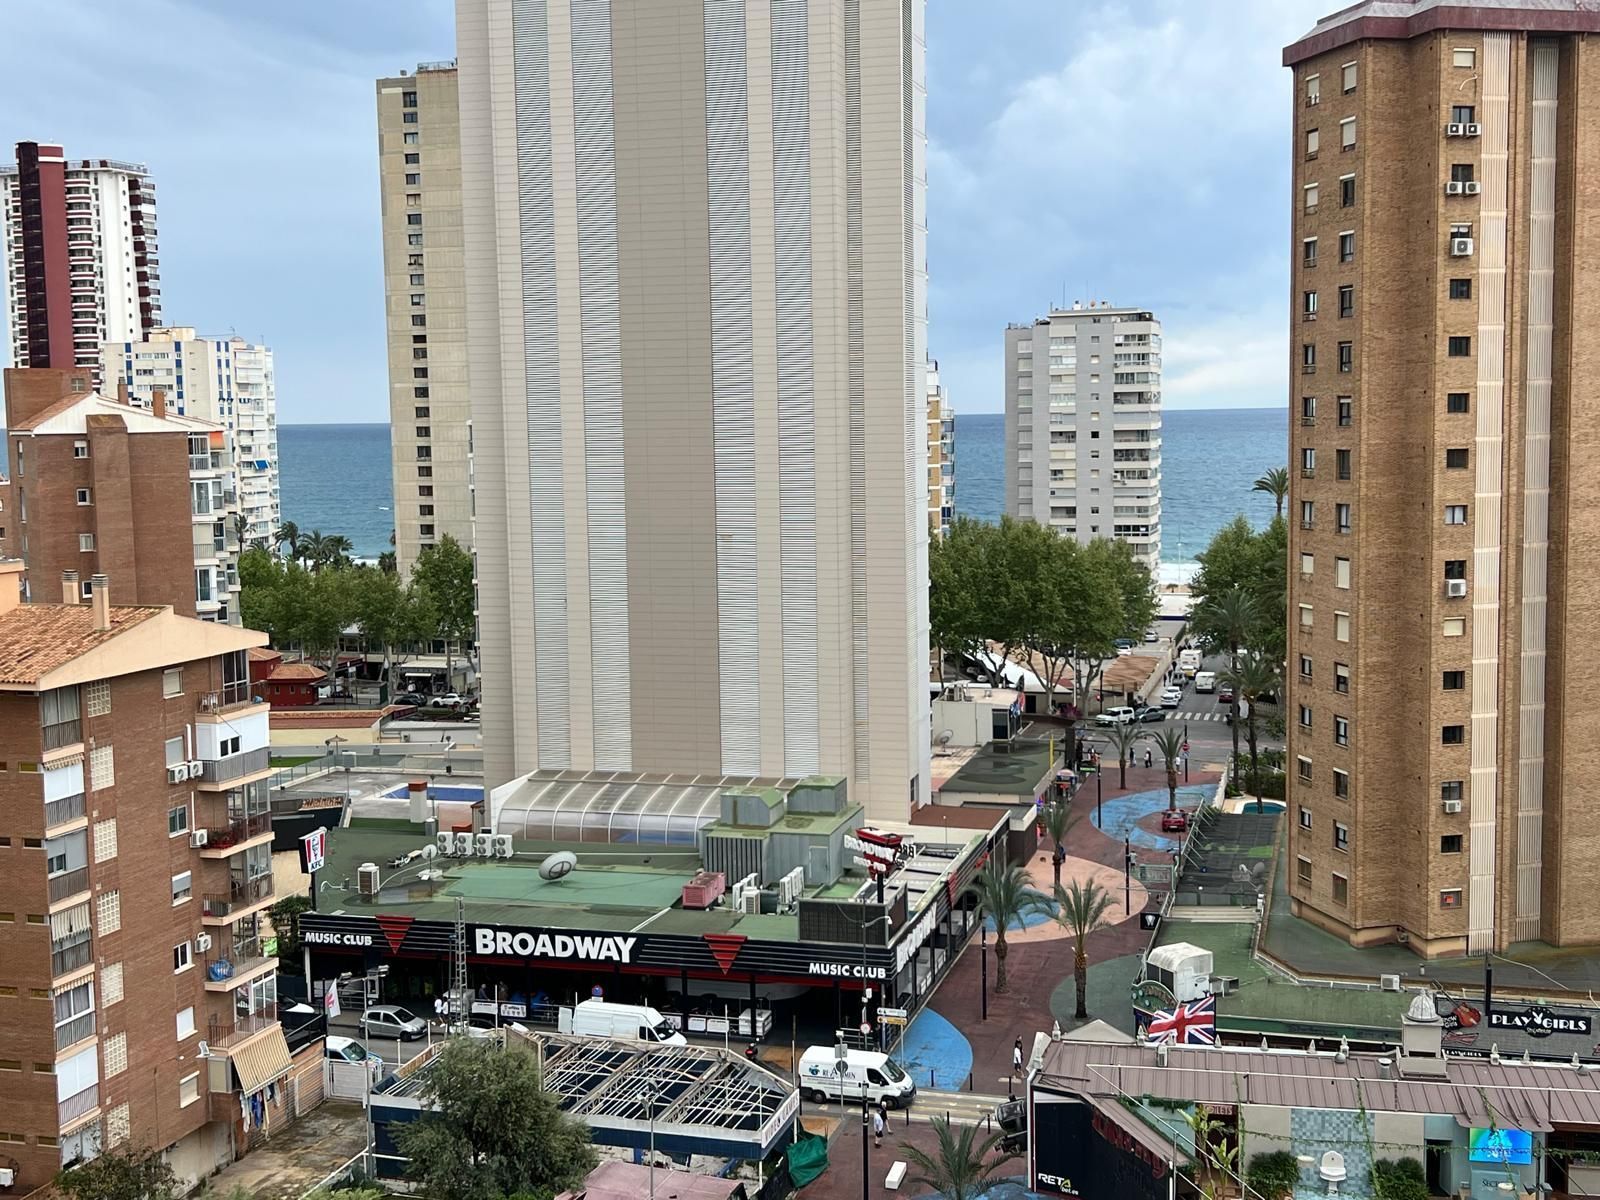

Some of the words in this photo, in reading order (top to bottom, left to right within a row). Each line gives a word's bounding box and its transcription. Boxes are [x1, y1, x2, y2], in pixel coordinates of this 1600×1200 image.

[844, 834, 894, 863] BROADWAY
[310, 859, 323, 871] KFC
[305, 932, 341, 944] MUSIC
[343, 934, 373, 946] CLUB
[475, 928, 637, 963] BROADWAY
[809, 962, 850, 976] MUSIC
[853, 966, 886, 979] CLUB
[1491, 1014, 1532, 1026] PLAY
[1542, 1018, 1587, 1031] GIRLS
[1038, 1173, 1072, 1189] RETA
